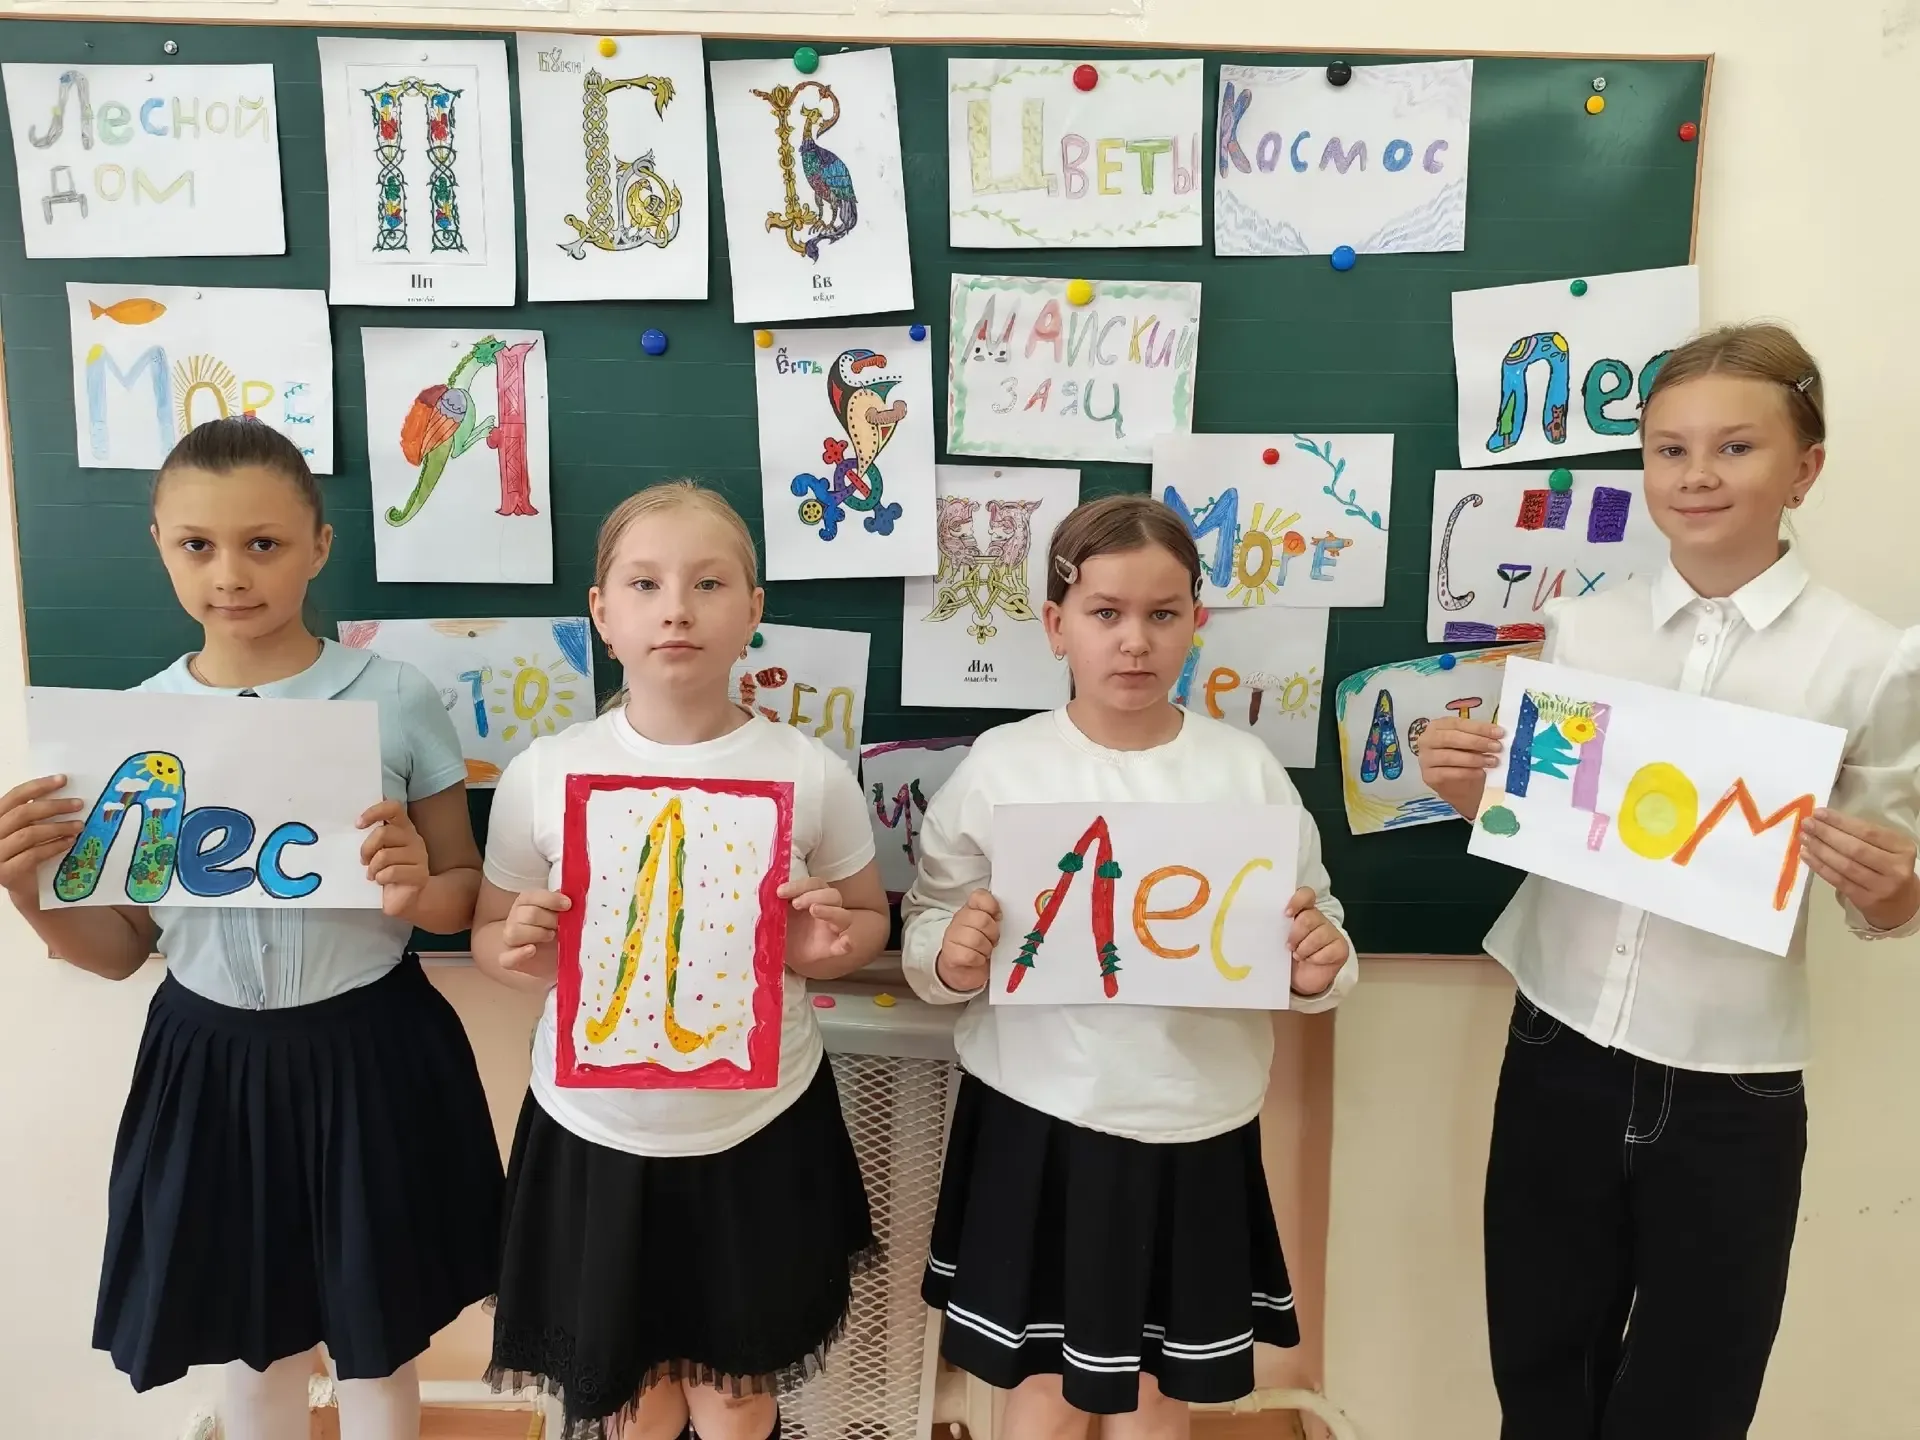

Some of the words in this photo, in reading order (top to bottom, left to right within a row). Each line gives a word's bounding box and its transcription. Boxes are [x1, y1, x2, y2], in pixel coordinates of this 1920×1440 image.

[28, 70, 270, 150] Лесной
[53, 750, 323, 904] Лес
[1006, 815, 1274, 998] Лес
